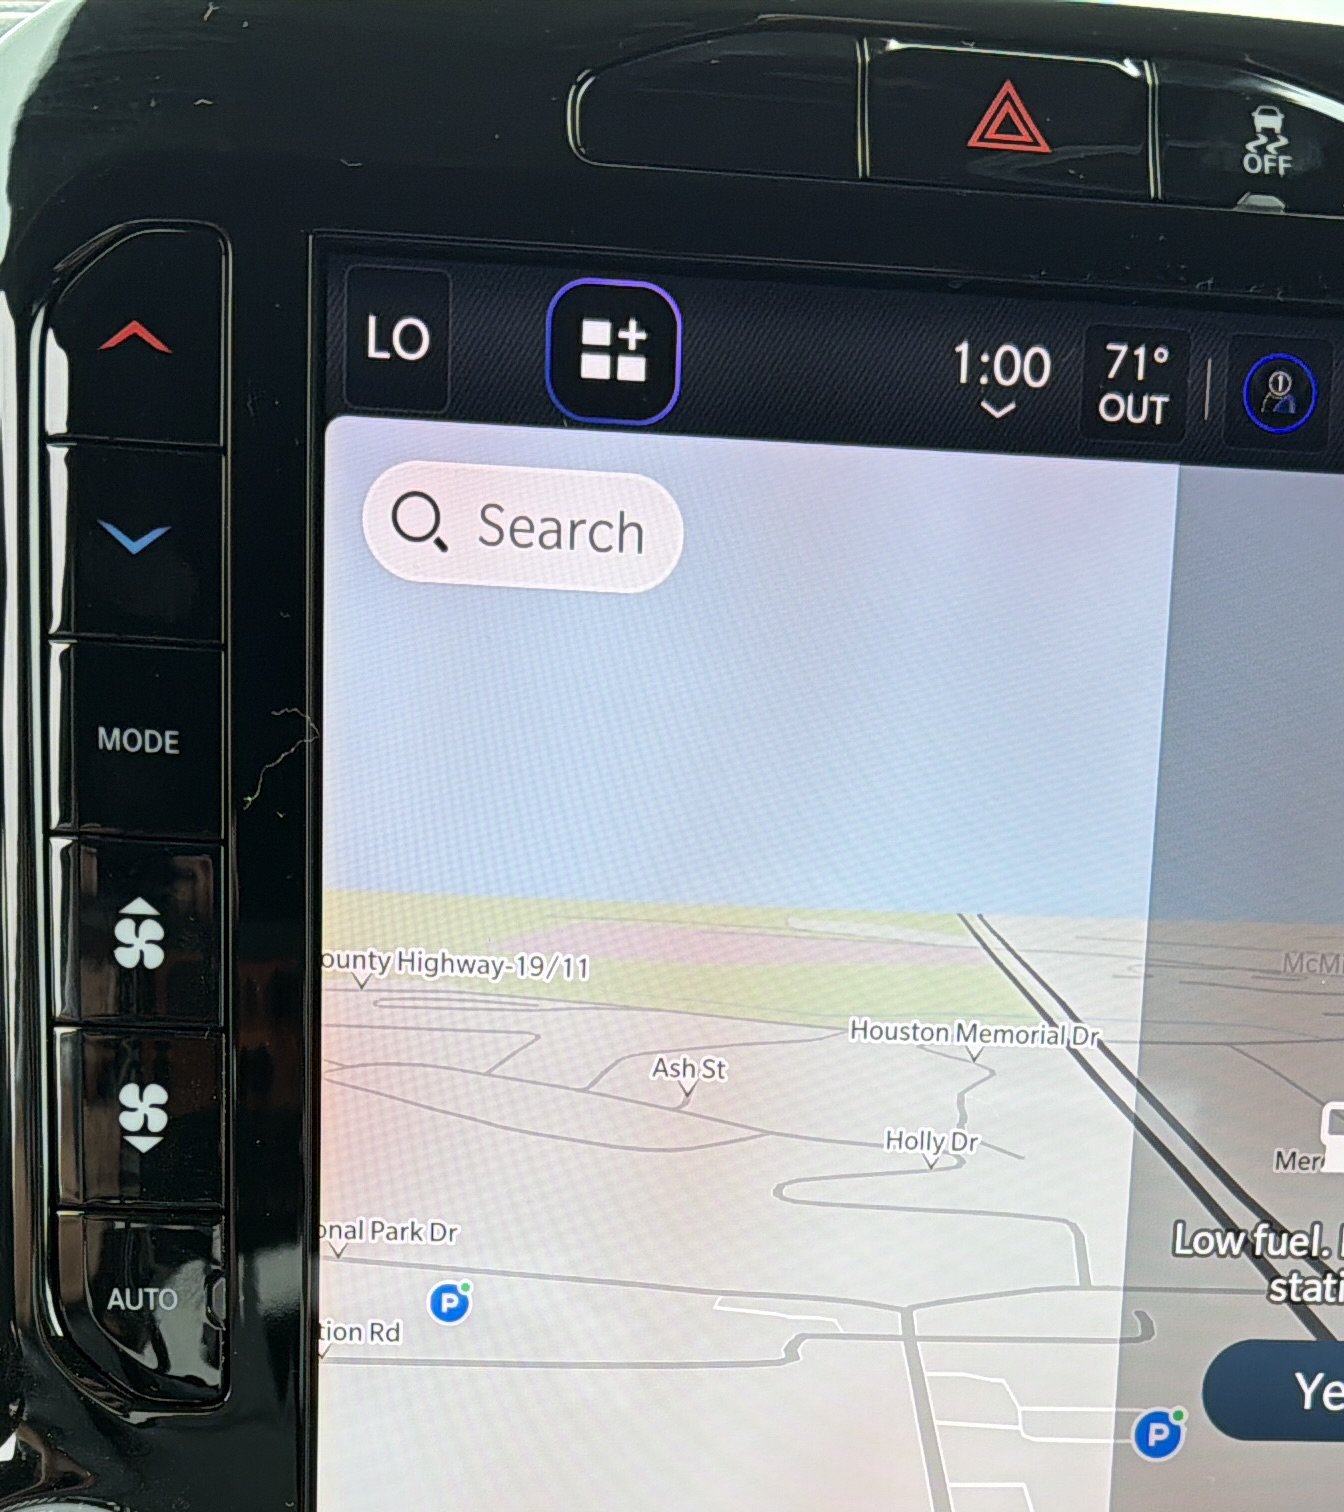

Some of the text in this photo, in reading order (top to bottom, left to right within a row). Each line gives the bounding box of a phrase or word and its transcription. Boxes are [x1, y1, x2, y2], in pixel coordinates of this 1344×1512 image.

[1242, 153, 1293, 176] OFF
[366, 313, 430, 361] LO
[954, 340, 1052, 389] 1:00
[1105, 343, 1170, 381] 71°
[1098, 393, 1169, 426] OUT
[478, 502, 645, 555] Search
[97, 726, 180, 755] MODE
[321, 951, 589, 979] ounty Highway-19/11
[850, 1018, 1100, 1047] Houston Memorial Dr
[652, 1058, 726, 1081] Ash St
[885, 1130, 978, 1156] Holly Dr
[371, 1220, 424, 1241] Park
[430, 1222, 458, 1243] Dr
[1174, 1222, 1245, 1257] Low
[1253, 1223, 1330, 1258] fuel.
[107, 1286, 178, 1312] AUTO
[440, 1292, 459, 1313] P
[370, 1321, 400, 1342] Rd
[1148, 1423, 1170, 1446] P
